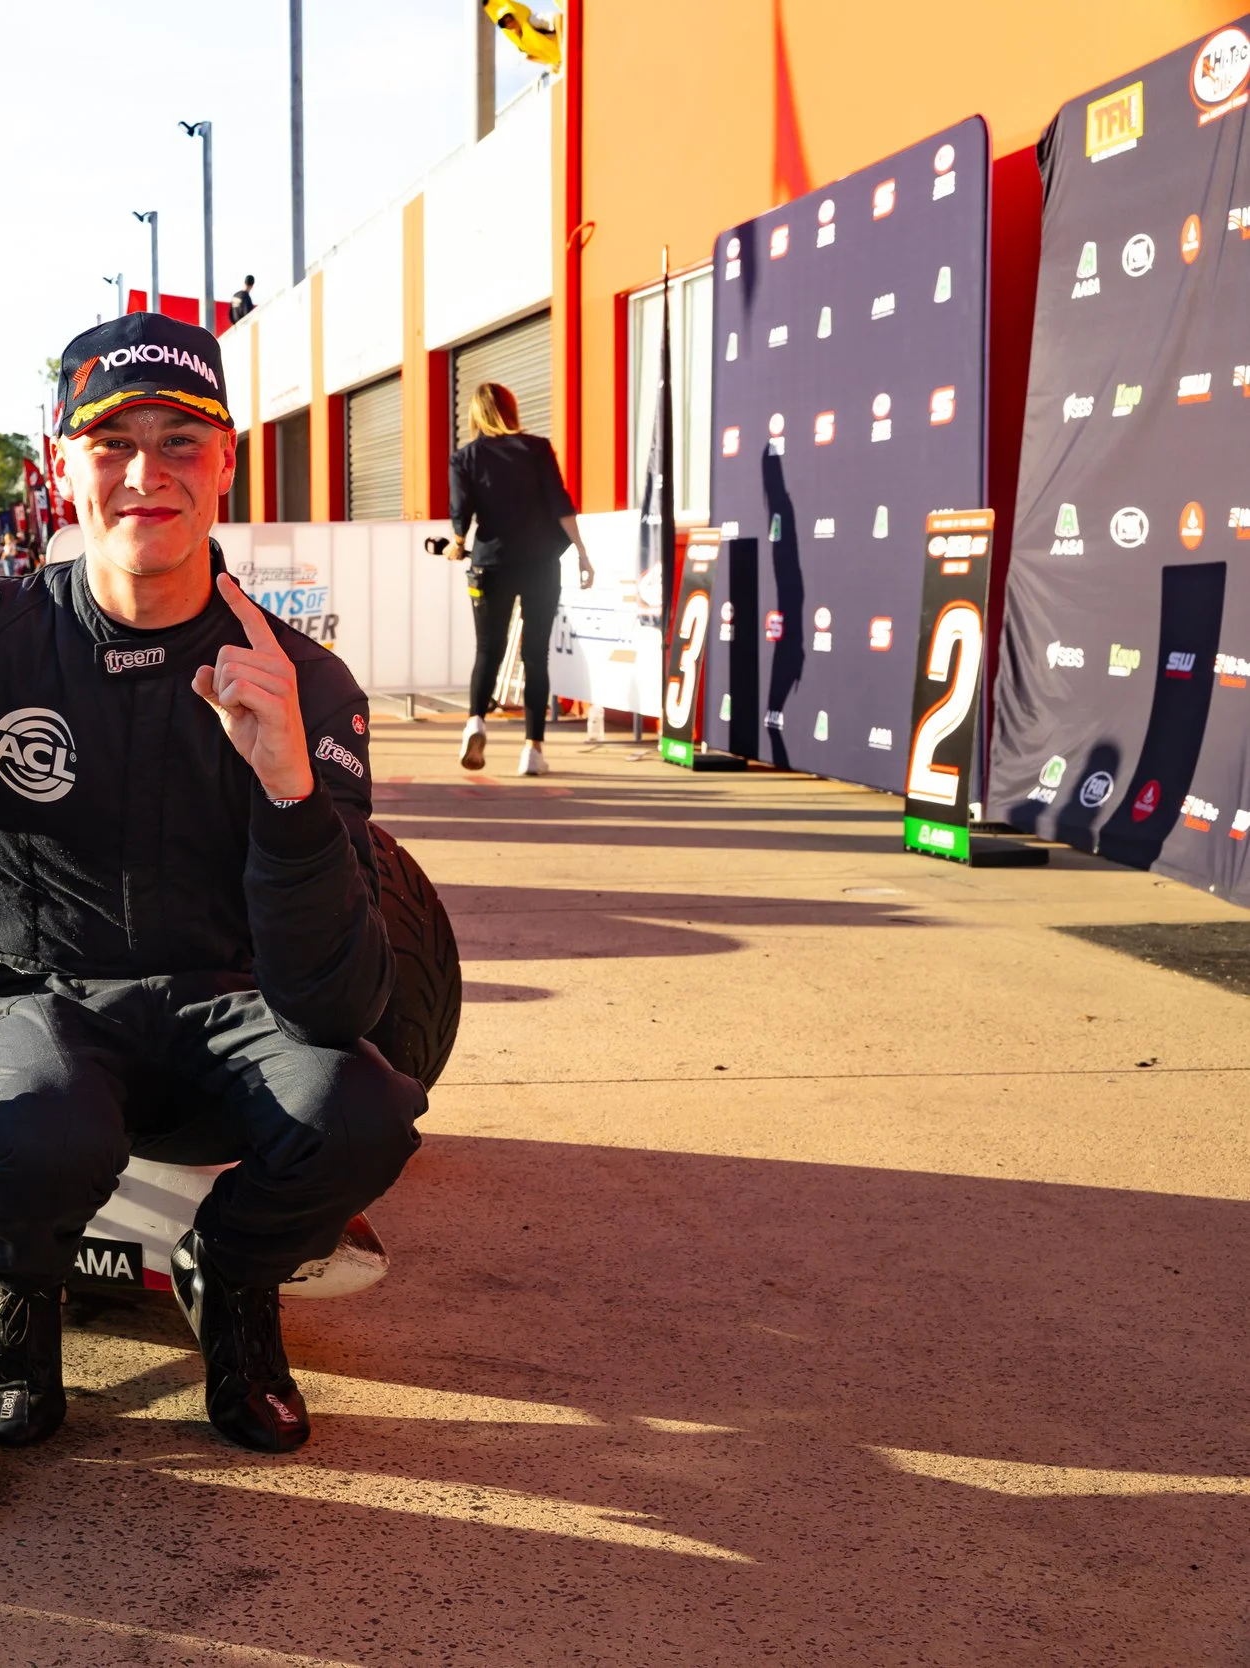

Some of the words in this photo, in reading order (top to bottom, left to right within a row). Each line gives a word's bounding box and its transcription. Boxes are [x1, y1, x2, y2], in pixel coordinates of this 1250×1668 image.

[99, 344, 218, 390] YOKOHAMA
[1050, 539, 1084, 556] AASA
[249, 588, 306, 616] AYS
[306, 591, 327, 610] OF
[105, 647, 165, 673] freem
[666, 588, 710, 729] 3
[1057, 646, 1085, 669] SBS
[1166, 651, 1196, 672] SW
[908, 599, 983, 806] 2
[315, 735, 364, 778] freem
[0, 1389, 21, 1420] freem
[266, 1392, 299, 1424] freem
